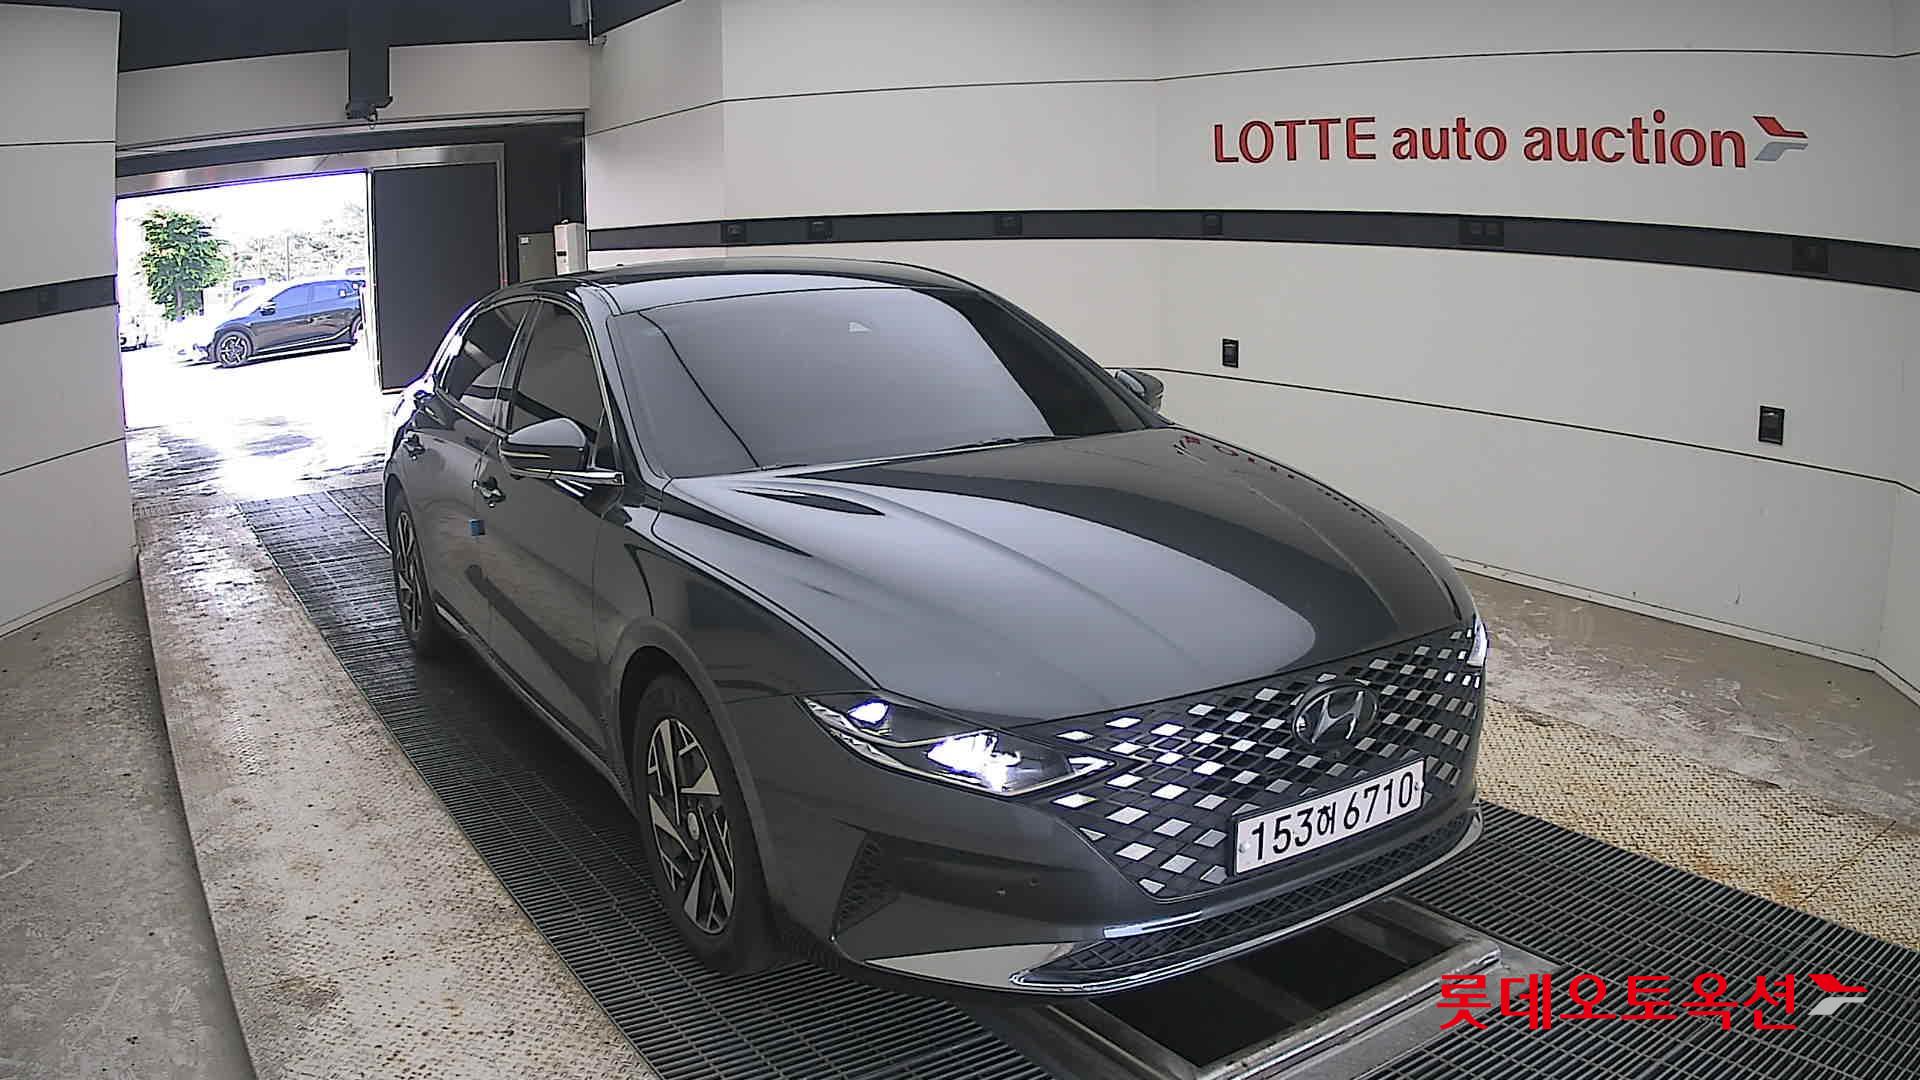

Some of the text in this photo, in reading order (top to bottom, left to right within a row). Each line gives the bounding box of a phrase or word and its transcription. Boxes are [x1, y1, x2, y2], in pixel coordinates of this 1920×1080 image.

[1212, 109, 1747, 168] LOTTE auto auction
